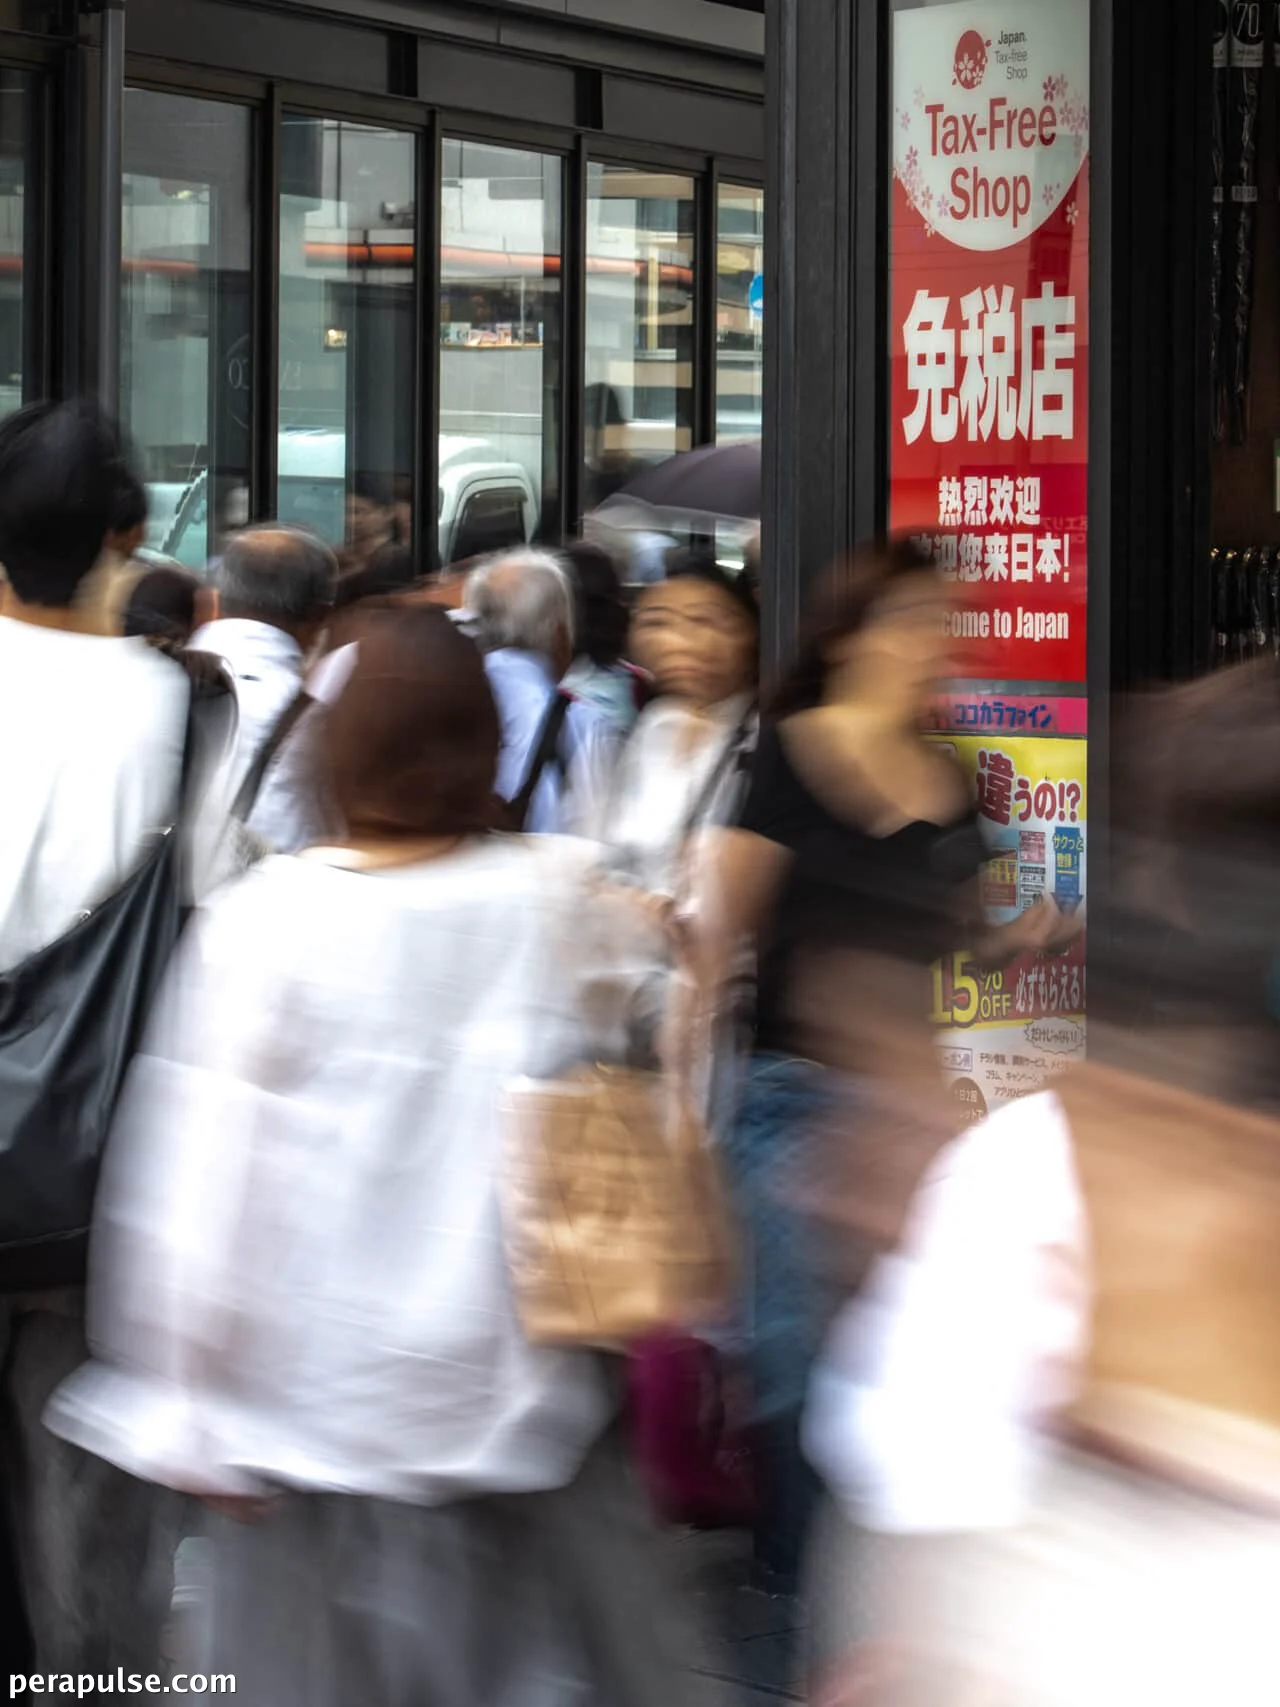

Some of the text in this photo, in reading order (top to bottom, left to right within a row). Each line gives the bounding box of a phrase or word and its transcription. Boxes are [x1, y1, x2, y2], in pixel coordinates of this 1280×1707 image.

[994, 48, 1028, 66] Tax-free
[1005, 64, 1028, 81] Shop
[924, 96, 1058, 156] Tax-Free
[948, 166, 1032, 229] Shop
[902, 281, 1077, 446] 免税店
[937, 475, 1041, 526] 热烈欢迎
[993, 607, 1012, 638] to
[1015, 606, 1069, 642] Japan
[929, 950, 979, 1023] 15
[980, 993, 1012, 1018] OFF
